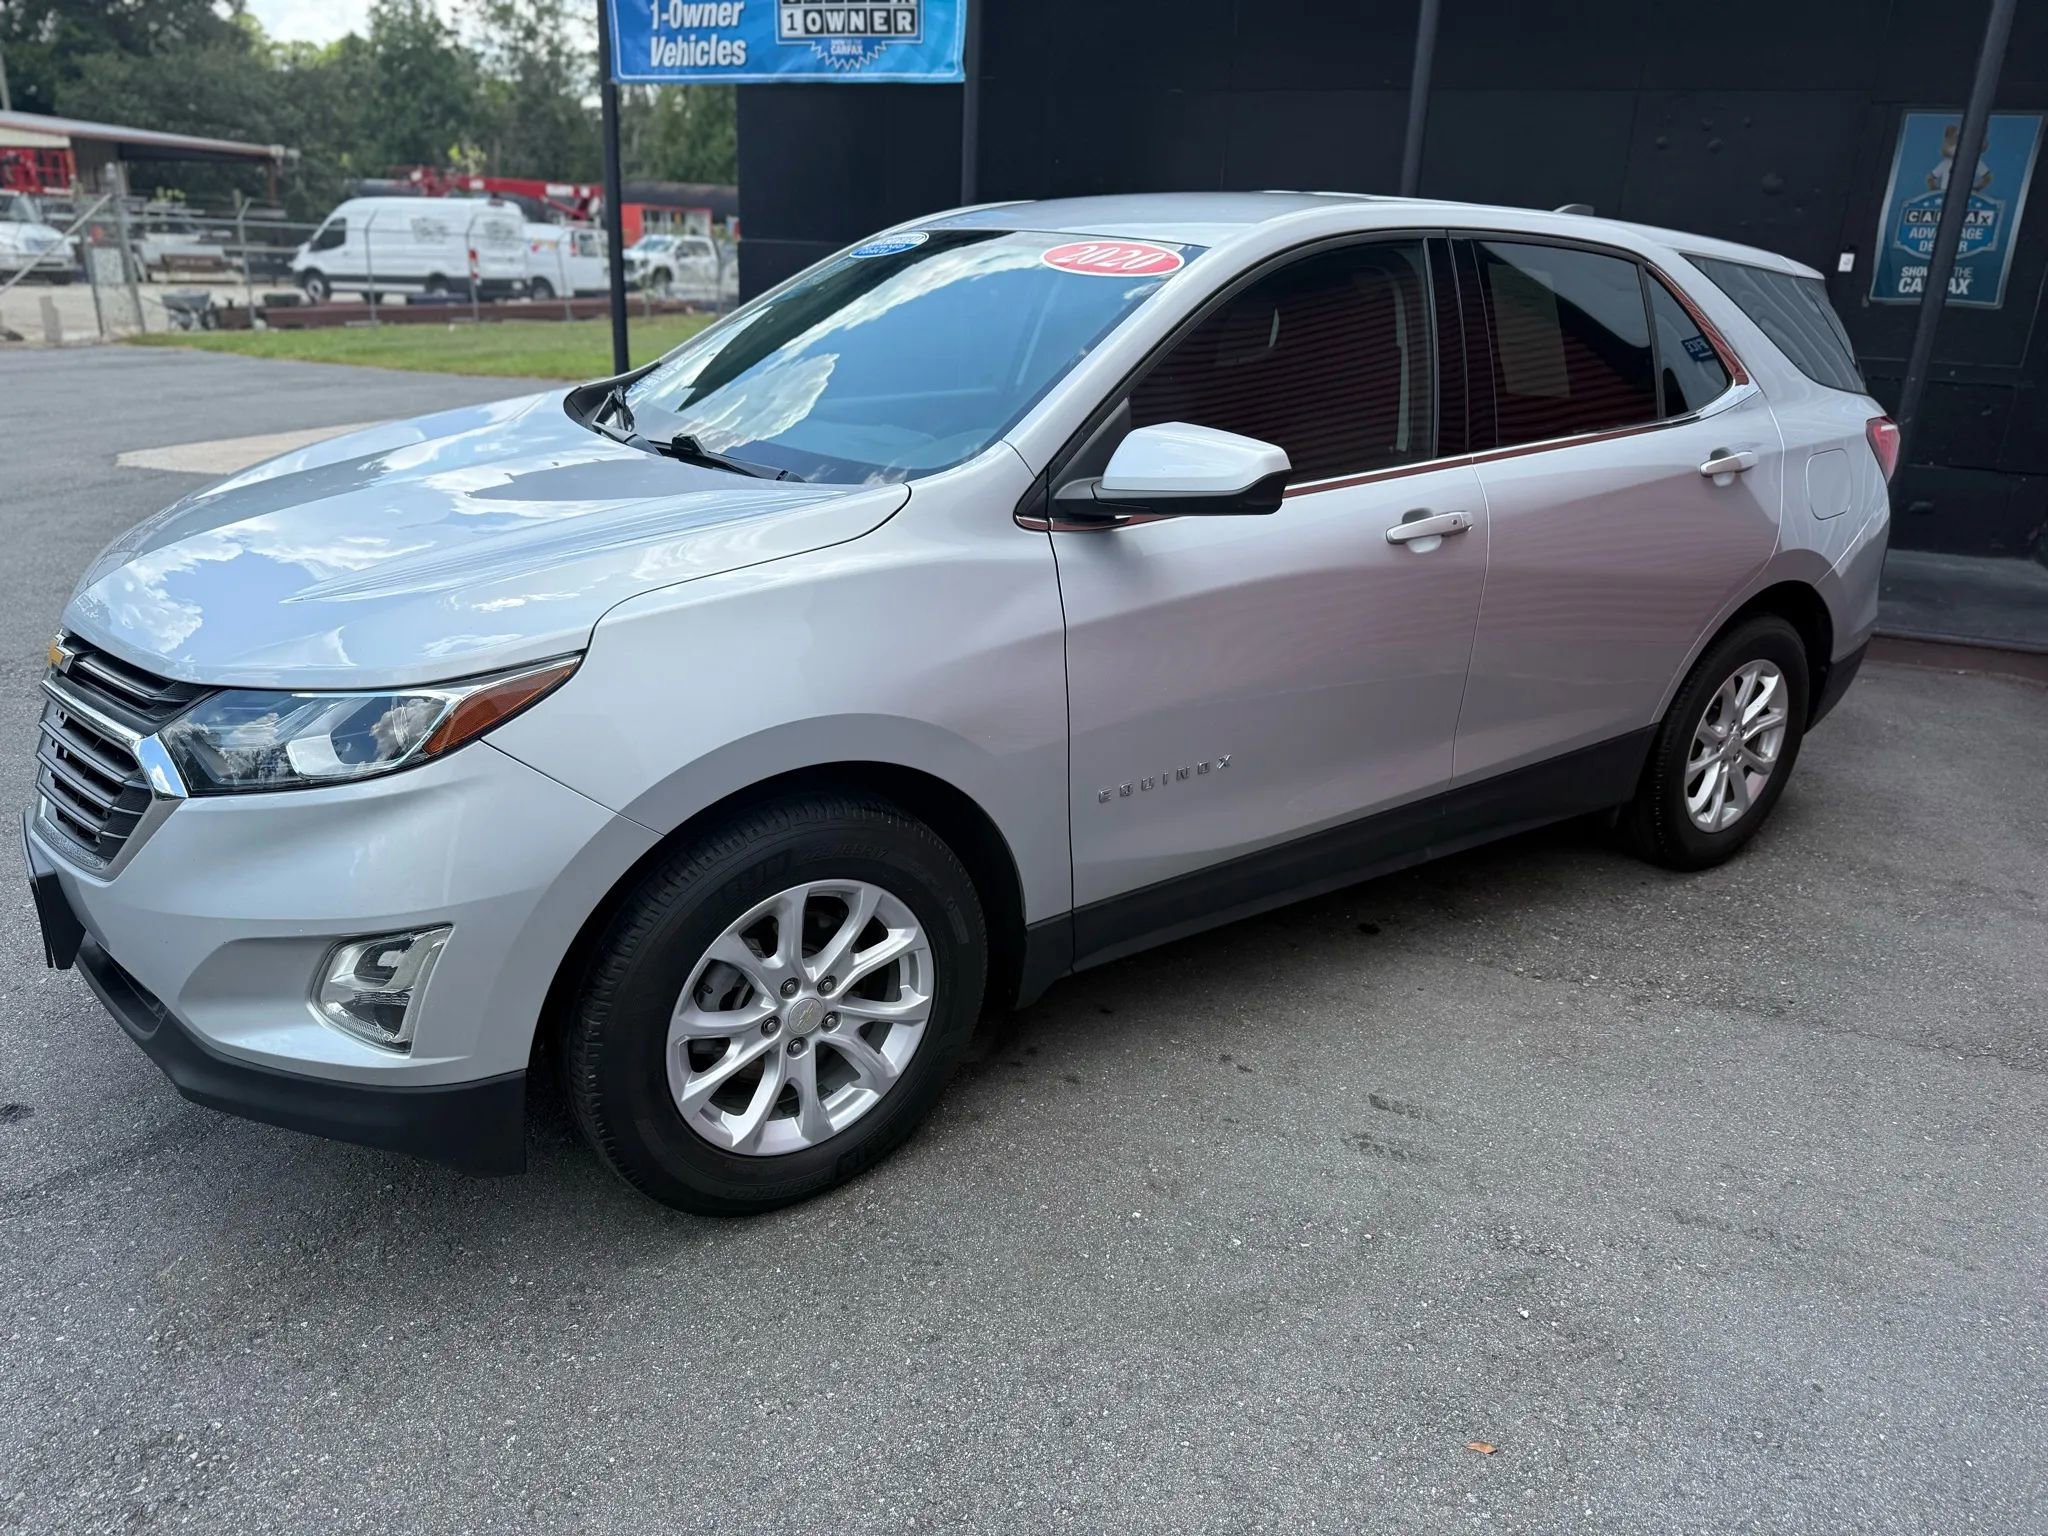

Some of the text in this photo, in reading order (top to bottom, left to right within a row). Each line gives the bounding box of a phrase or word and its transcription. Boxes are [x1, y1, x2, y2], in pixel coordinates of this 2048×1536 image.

[650, 0, 745, 30] 1-Owner
[650, 33, 747, 67] Vehicles
[1909, 212, 1991, 224] CAAX
[1054, 245, 1167, 270] 2020
[1954, 266, 1973, 277] THE
[1898, 277, 1970, 294] CAAX
[1098, 754, 1232, 803] EQUINOX
